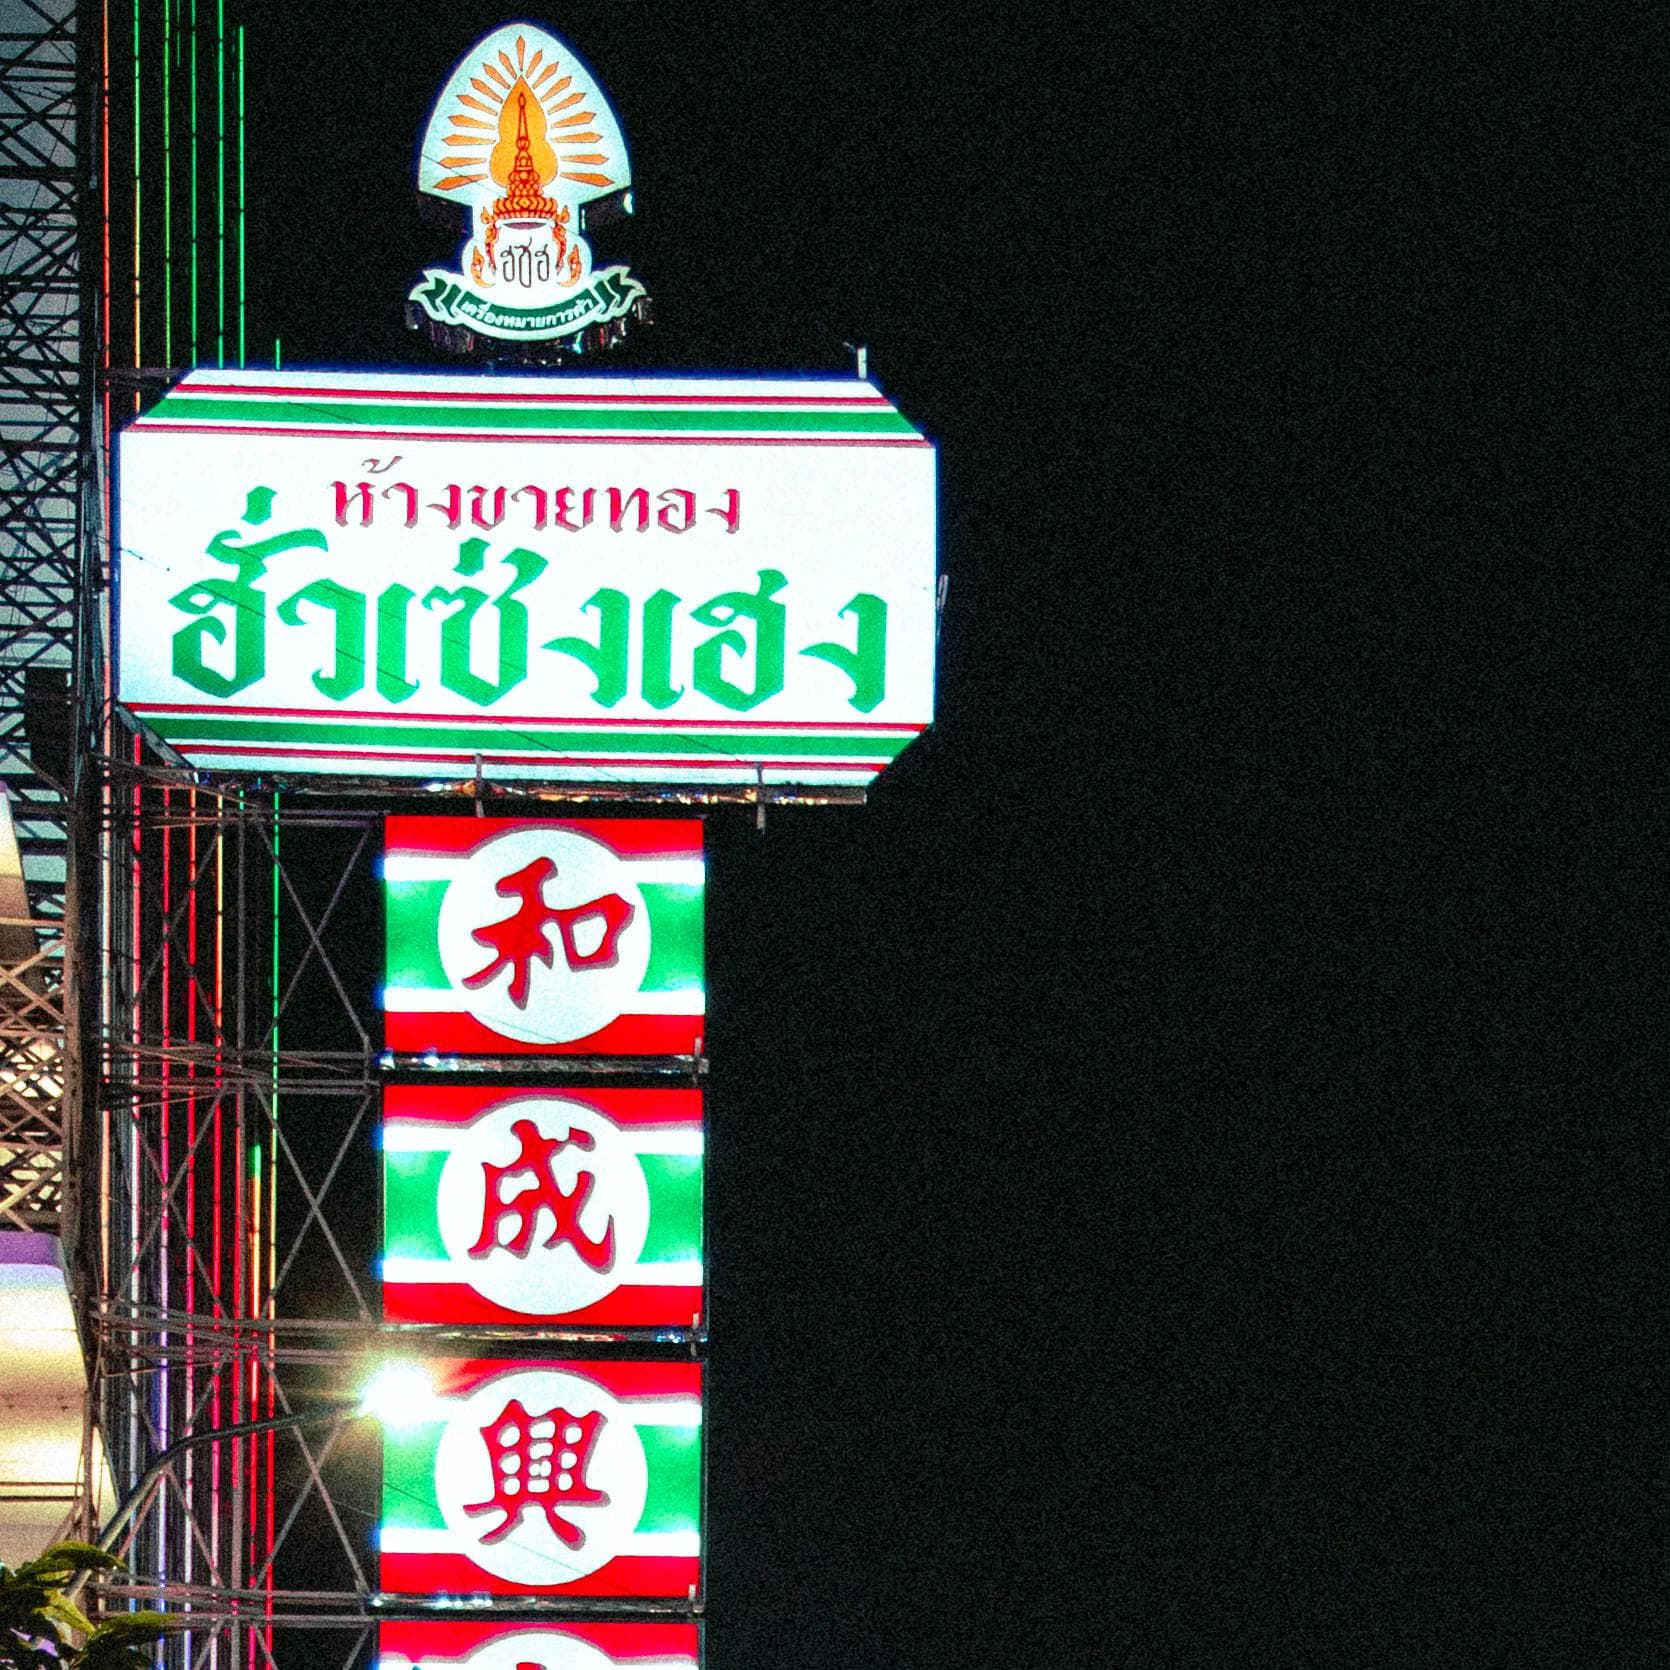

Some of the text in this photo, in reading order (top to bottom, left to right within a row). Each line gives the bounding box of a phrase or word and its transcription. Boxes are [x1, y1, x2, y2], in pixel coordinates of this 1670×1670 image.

[460, 298, 594, 329] เครื่องหมายการค้า
[331, 454, 741, 536] ห้างขายทอง
[168, 485, 889, 716] ฮั่วเซ่งเฮง
